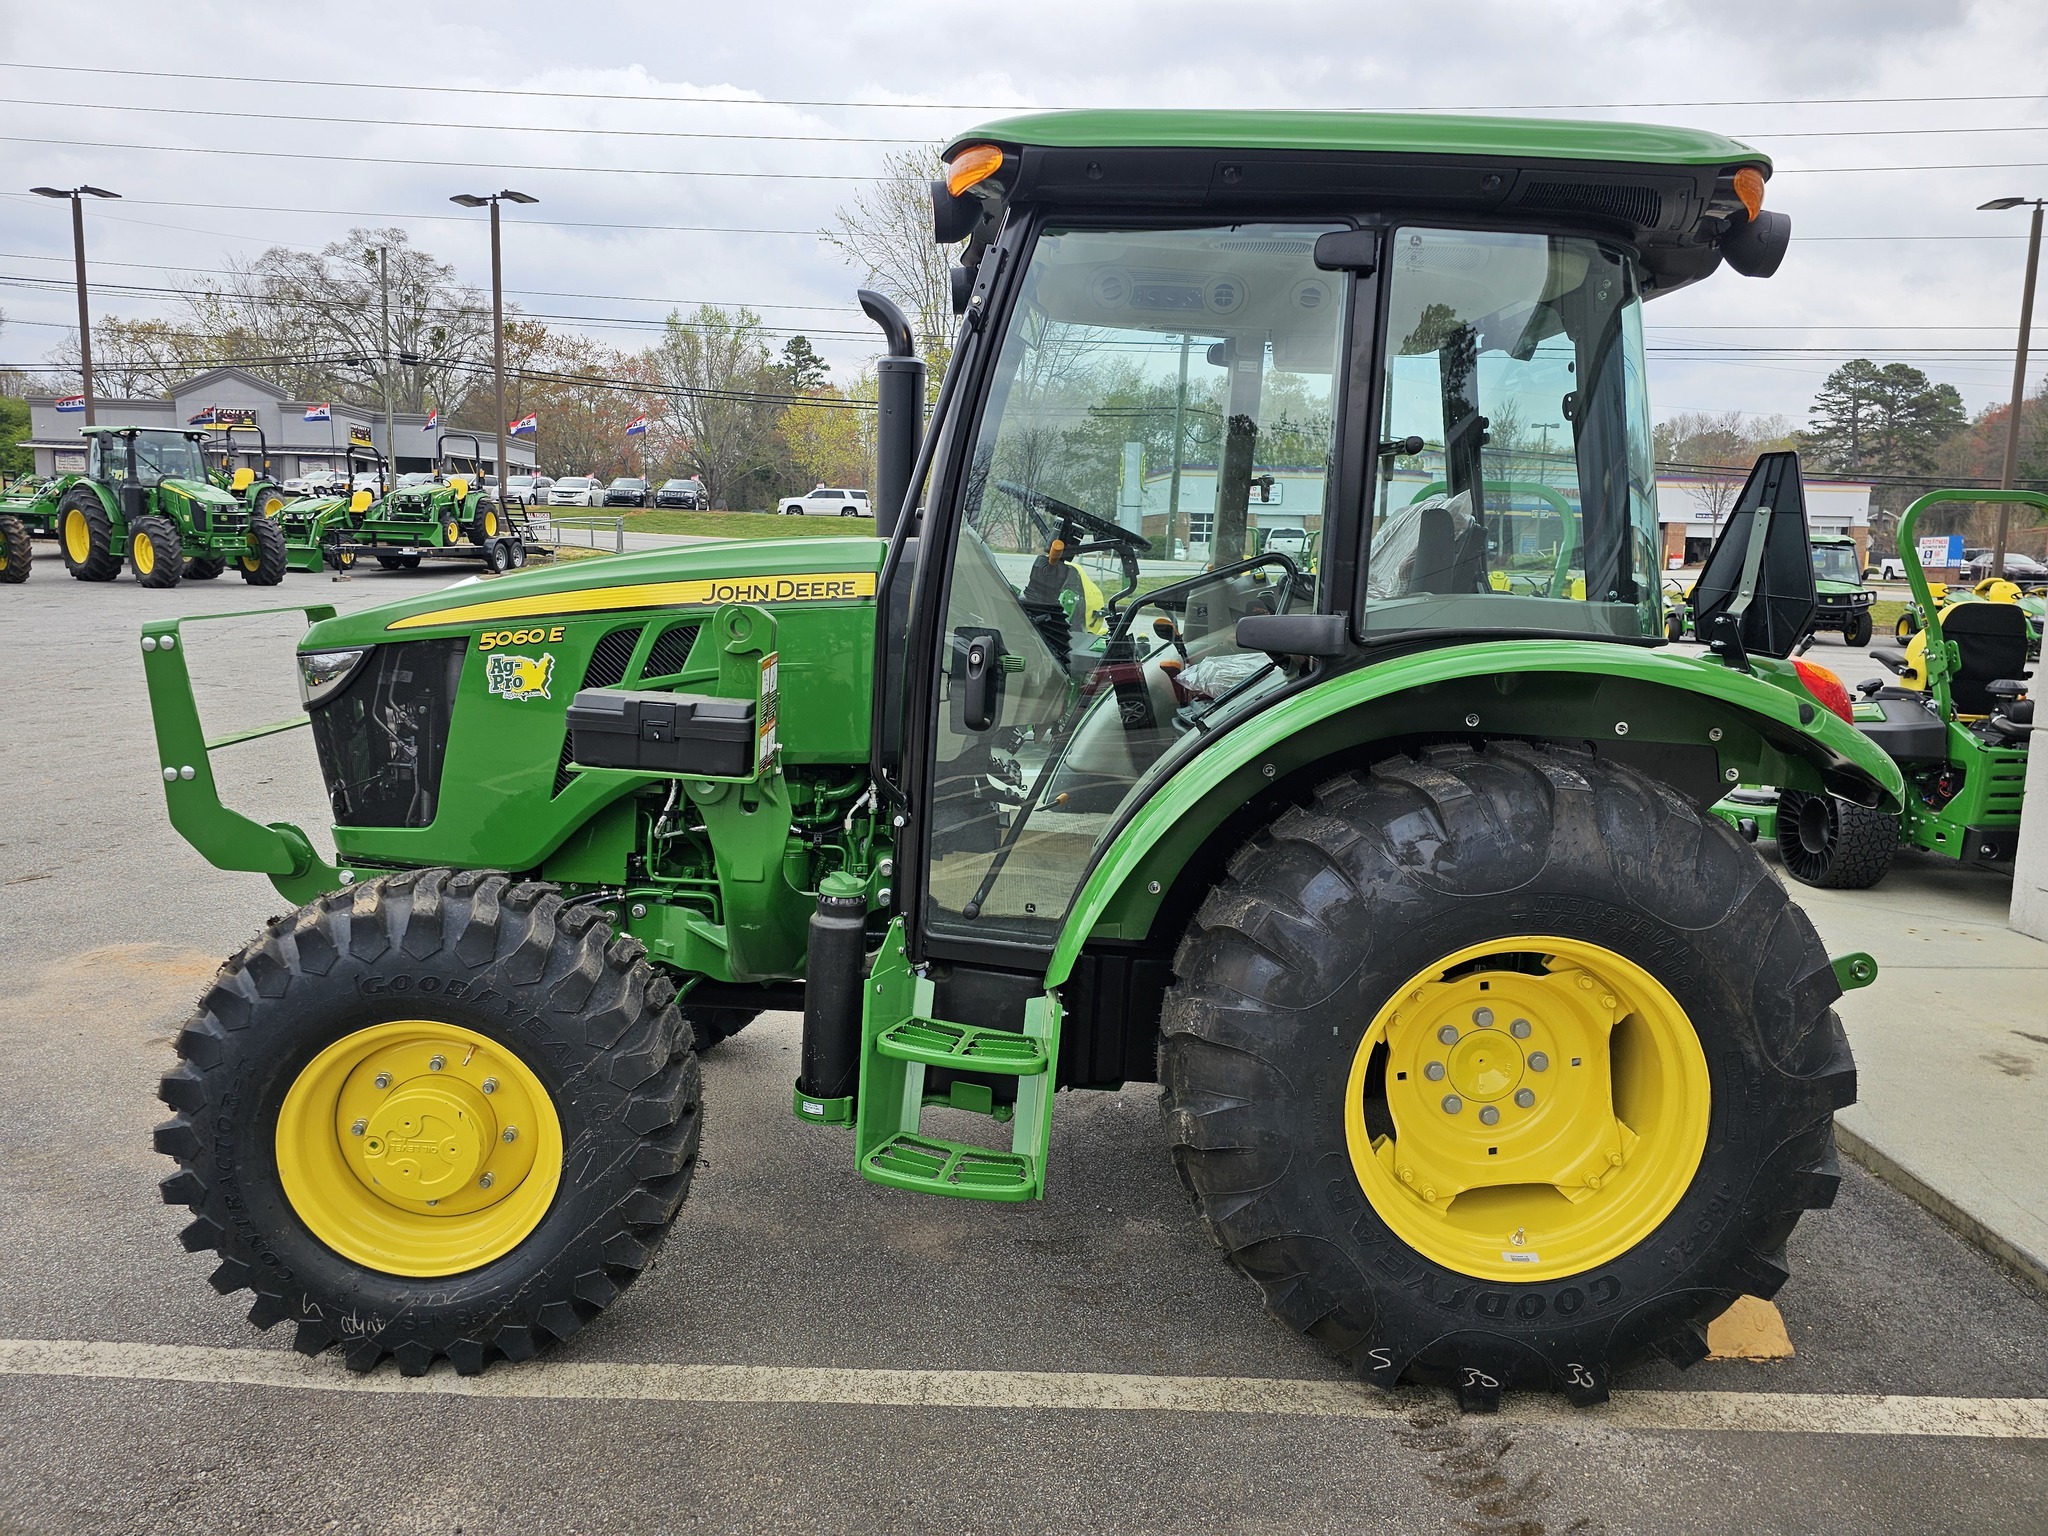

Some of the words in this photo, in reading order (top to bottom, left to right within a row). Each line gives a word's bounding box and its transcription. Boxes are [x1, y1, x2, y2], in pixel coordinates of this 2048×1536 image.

[702, 583, 770, 602] JOHN
[776, 580, 856, 599] DEERE
[478, 628, 546, 651] 5060
[548, 626, 565, 643] E
[492, 674, 523, 691] Pro
[1511, 913, 1642, 951] TRACTOR
[1648, 950, 1695, 991] LUG
[1535, 895, 1691, 966] INDUSTRIAL
[360, 974, 600, 1090] GOODYEAR
[422, 1144, 439, 1155] OIL
[1326, 1176, 1623, 1322] GOODYEAR
